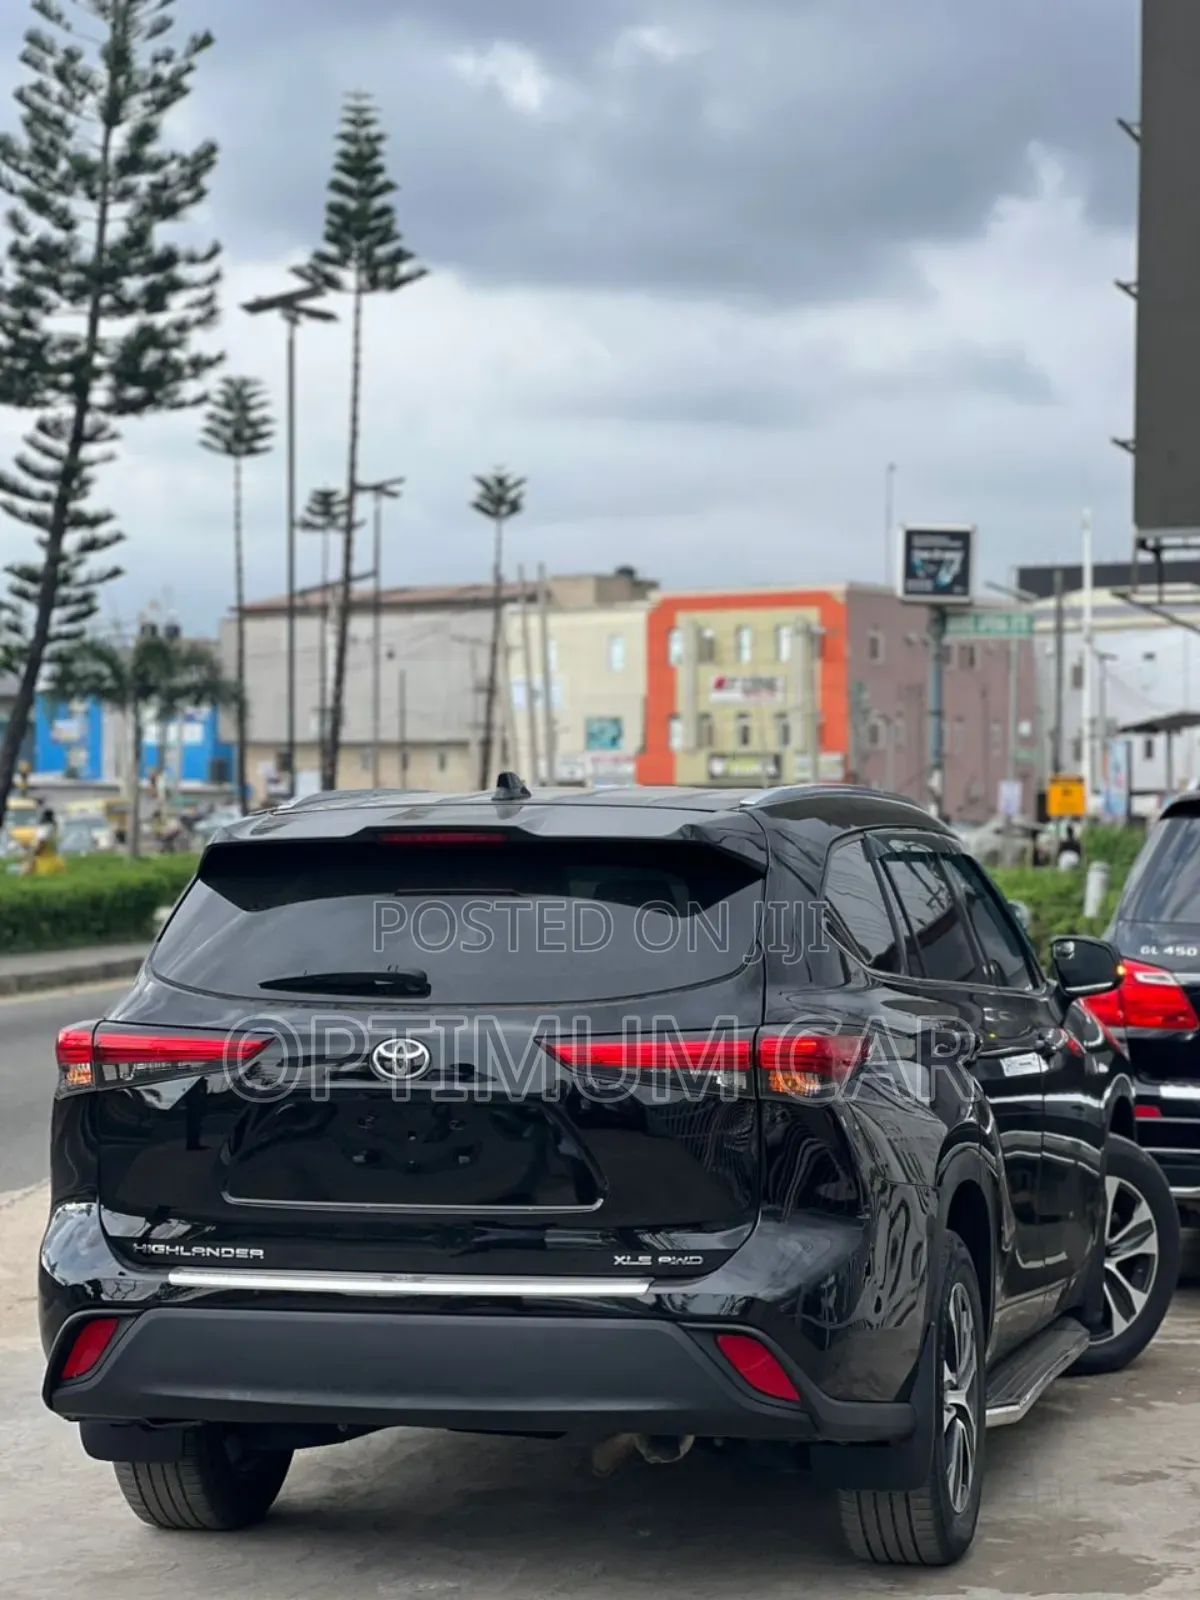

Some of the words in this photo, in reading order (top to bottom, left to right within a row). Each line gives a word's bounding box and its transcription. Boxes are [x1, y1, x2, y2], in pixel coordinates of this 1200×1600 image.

[1140, 945, 1159, 955] GL
[1163, 945, 1198, 957] 450
[133, 1243, 264, 1259] HIGHLANDER
[613, 1255, 652, 1266] XLE
